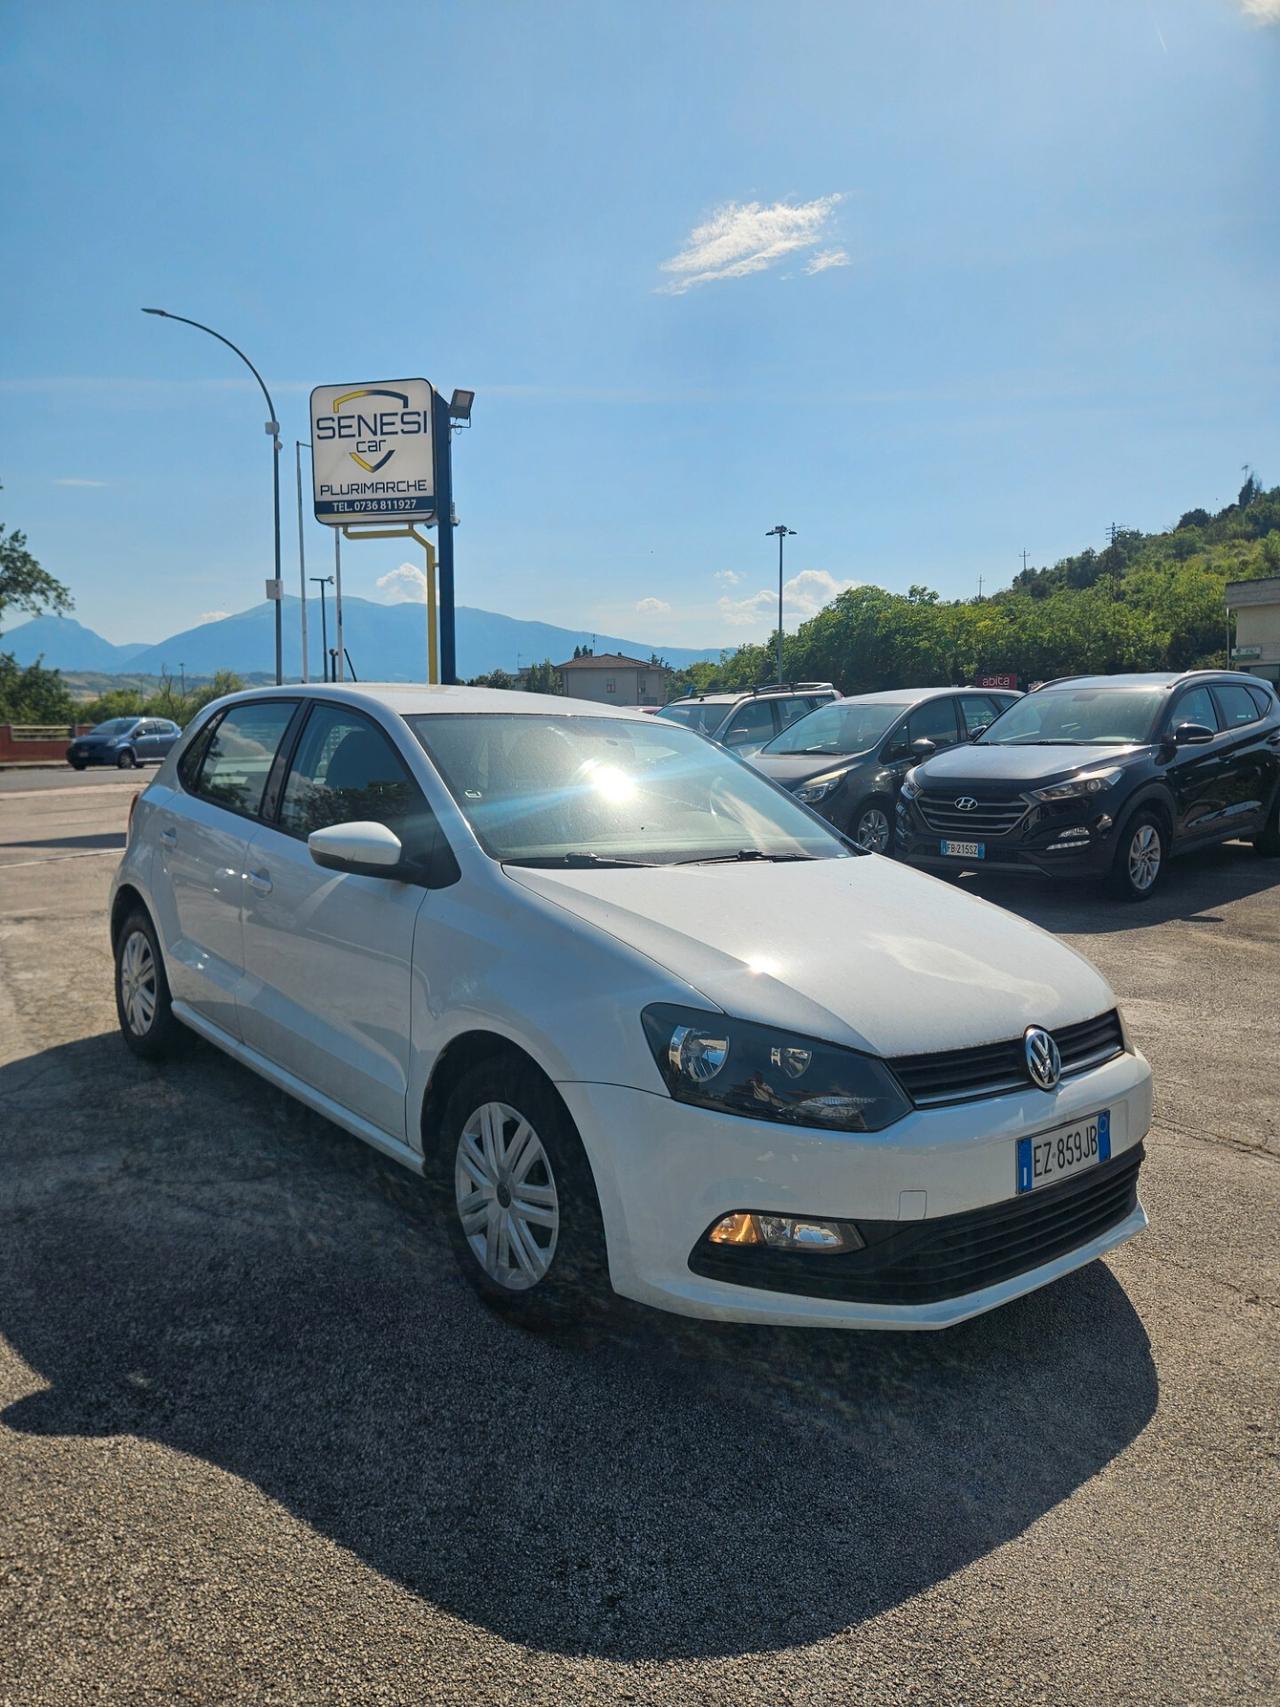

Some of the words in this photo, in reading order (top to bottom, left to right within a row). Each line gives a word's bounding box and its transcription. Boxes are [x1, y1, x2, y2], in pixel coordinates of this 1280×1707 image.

[316, 410, 428, 440] SENESI
[356, 439, 387, 454] car
[320, 479, 428, 496] PLURIMARCHE
[332, 502, 353, 512] TEL.
[354, 501, 378, 511] 0736
[380, 499, 417, 510] 811927
